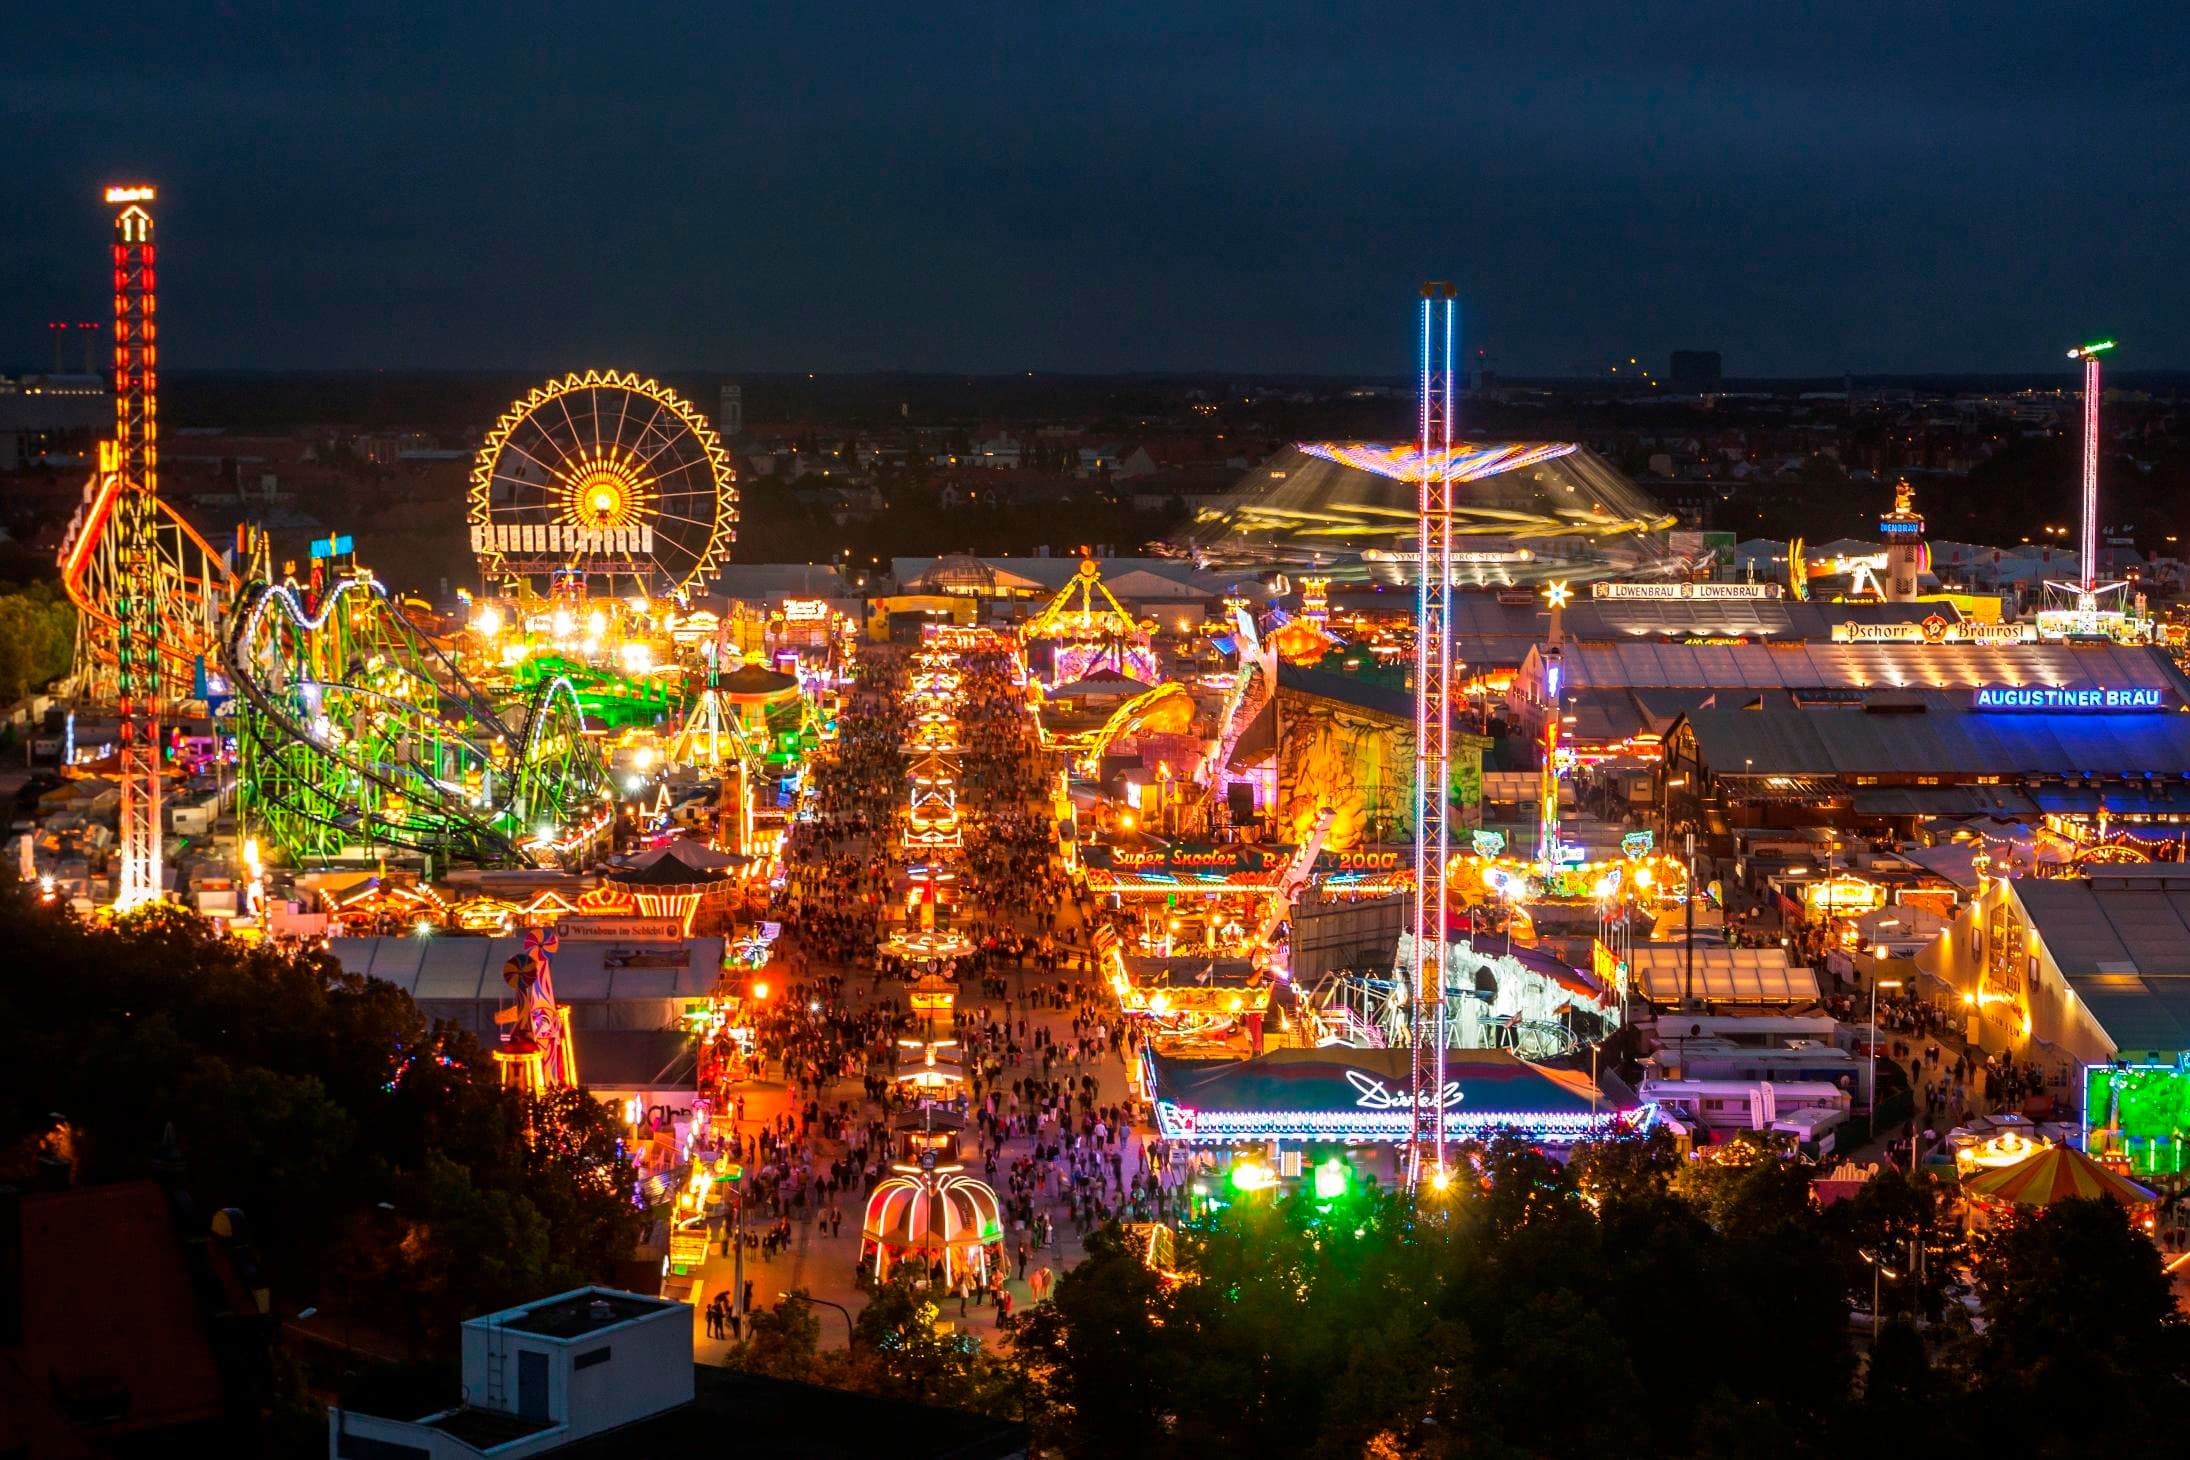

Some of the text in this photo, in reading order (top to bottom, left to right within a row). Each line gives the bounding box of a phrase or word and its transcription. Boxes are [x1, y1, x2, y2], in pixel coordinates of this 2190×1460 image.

[1978, 687, 2160, 706] AUGUSTINER BRÄU
[1112, 846, 1166, 869] Super
